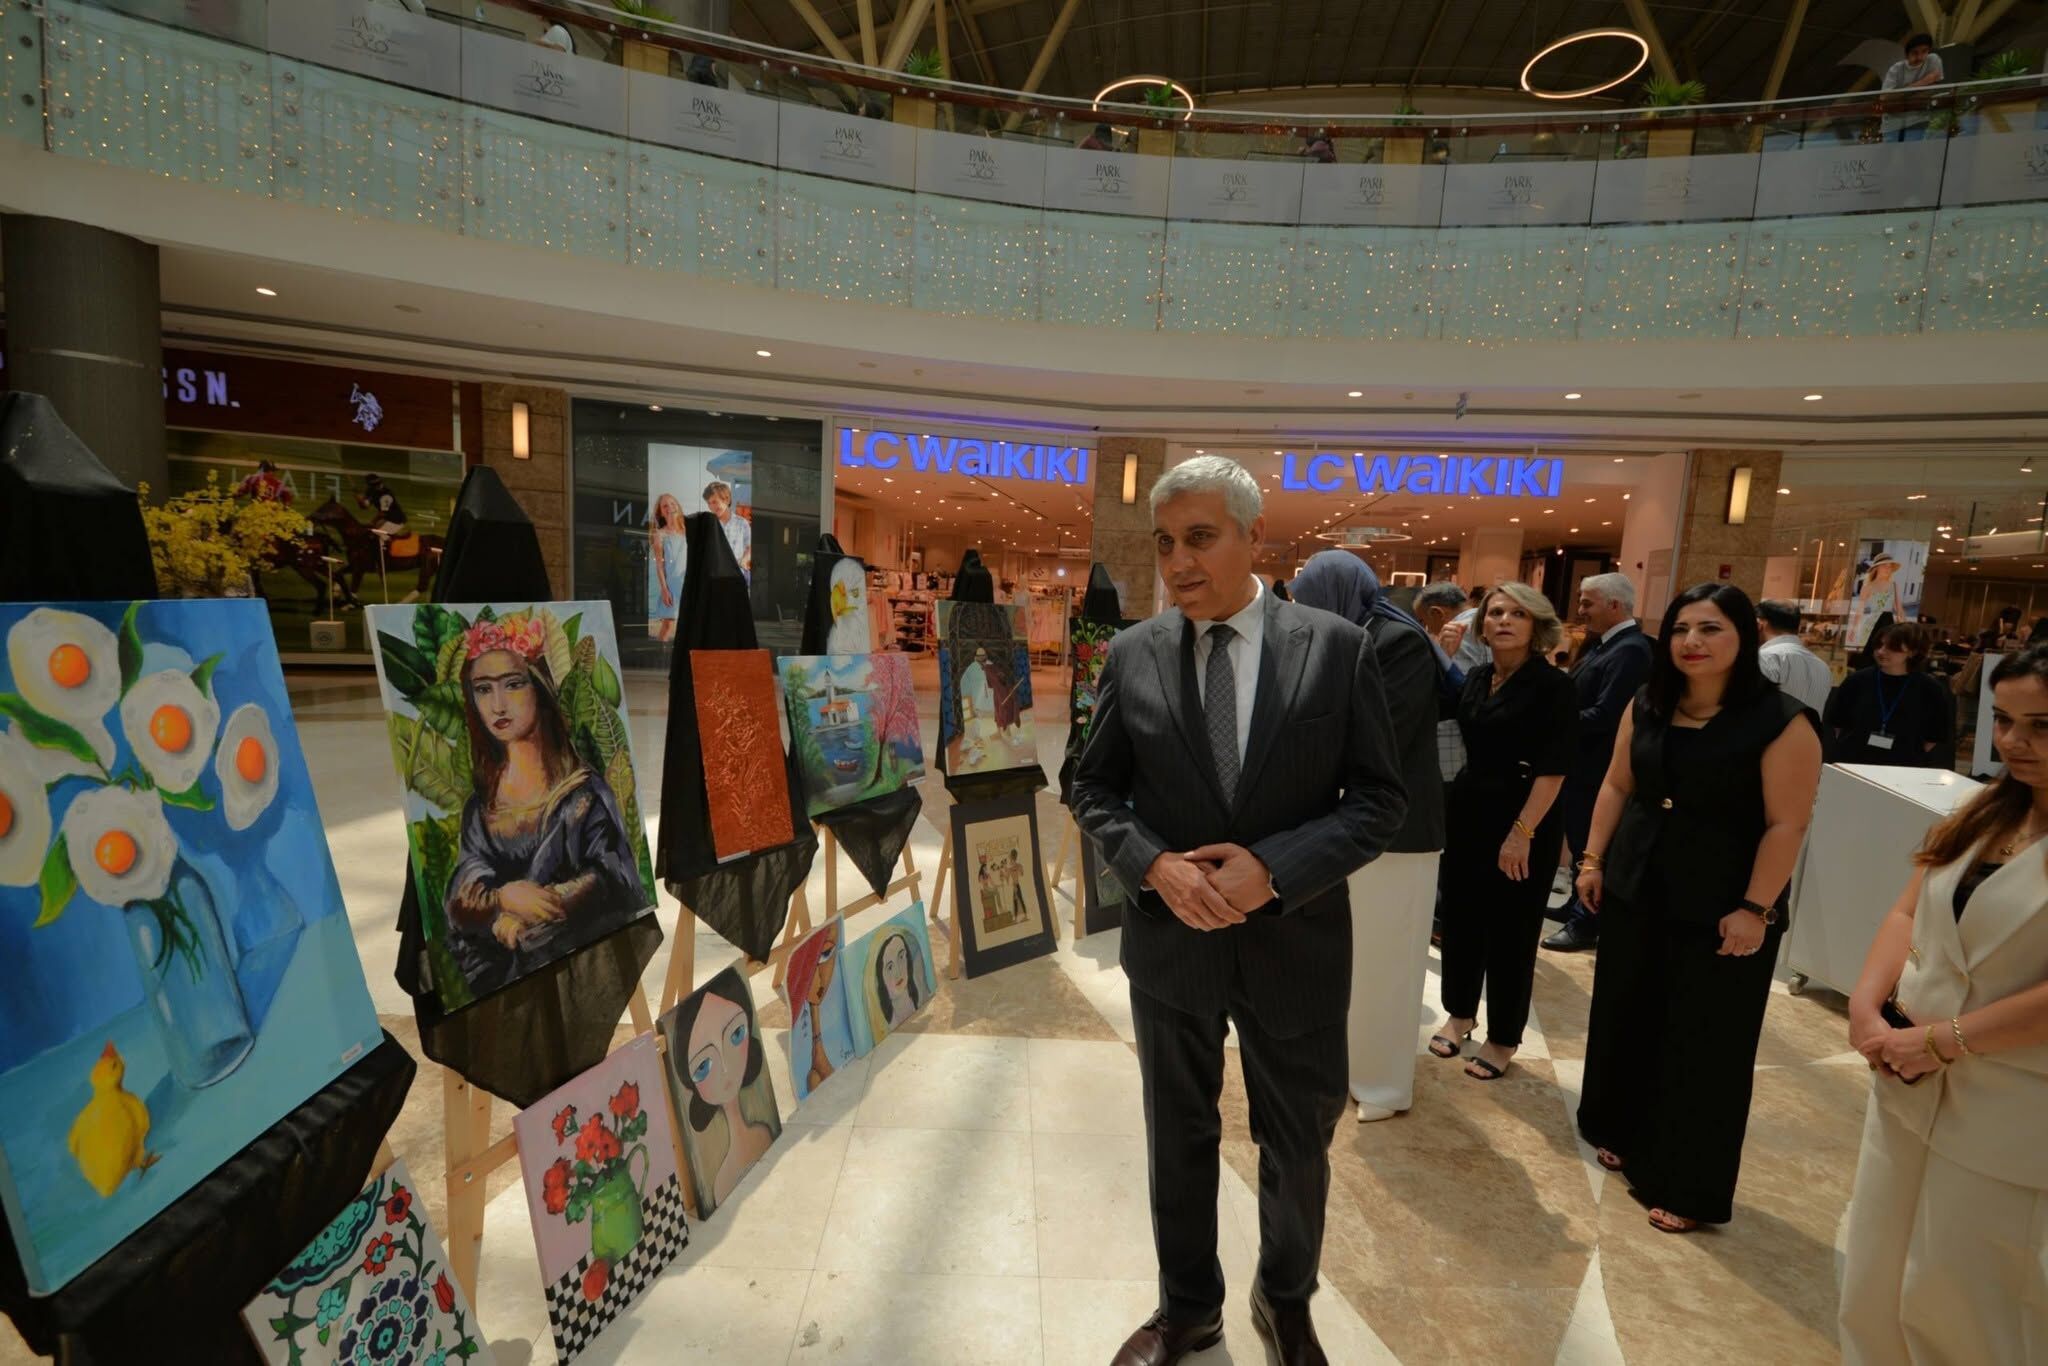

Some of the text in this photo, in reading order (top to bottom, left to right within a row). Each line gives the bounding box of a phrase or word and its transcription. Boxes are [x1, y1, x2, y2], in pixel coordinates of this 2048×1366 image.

[692, 97, 722, 115] PARK
[834, 127, 863, 143] PARK
[1096, 162, 1121, 178] PARK
[1504, 175, 1533, 188] PARK
[840, 428, 900, 469] LC
[1282, 454, 1345, 492] LC
